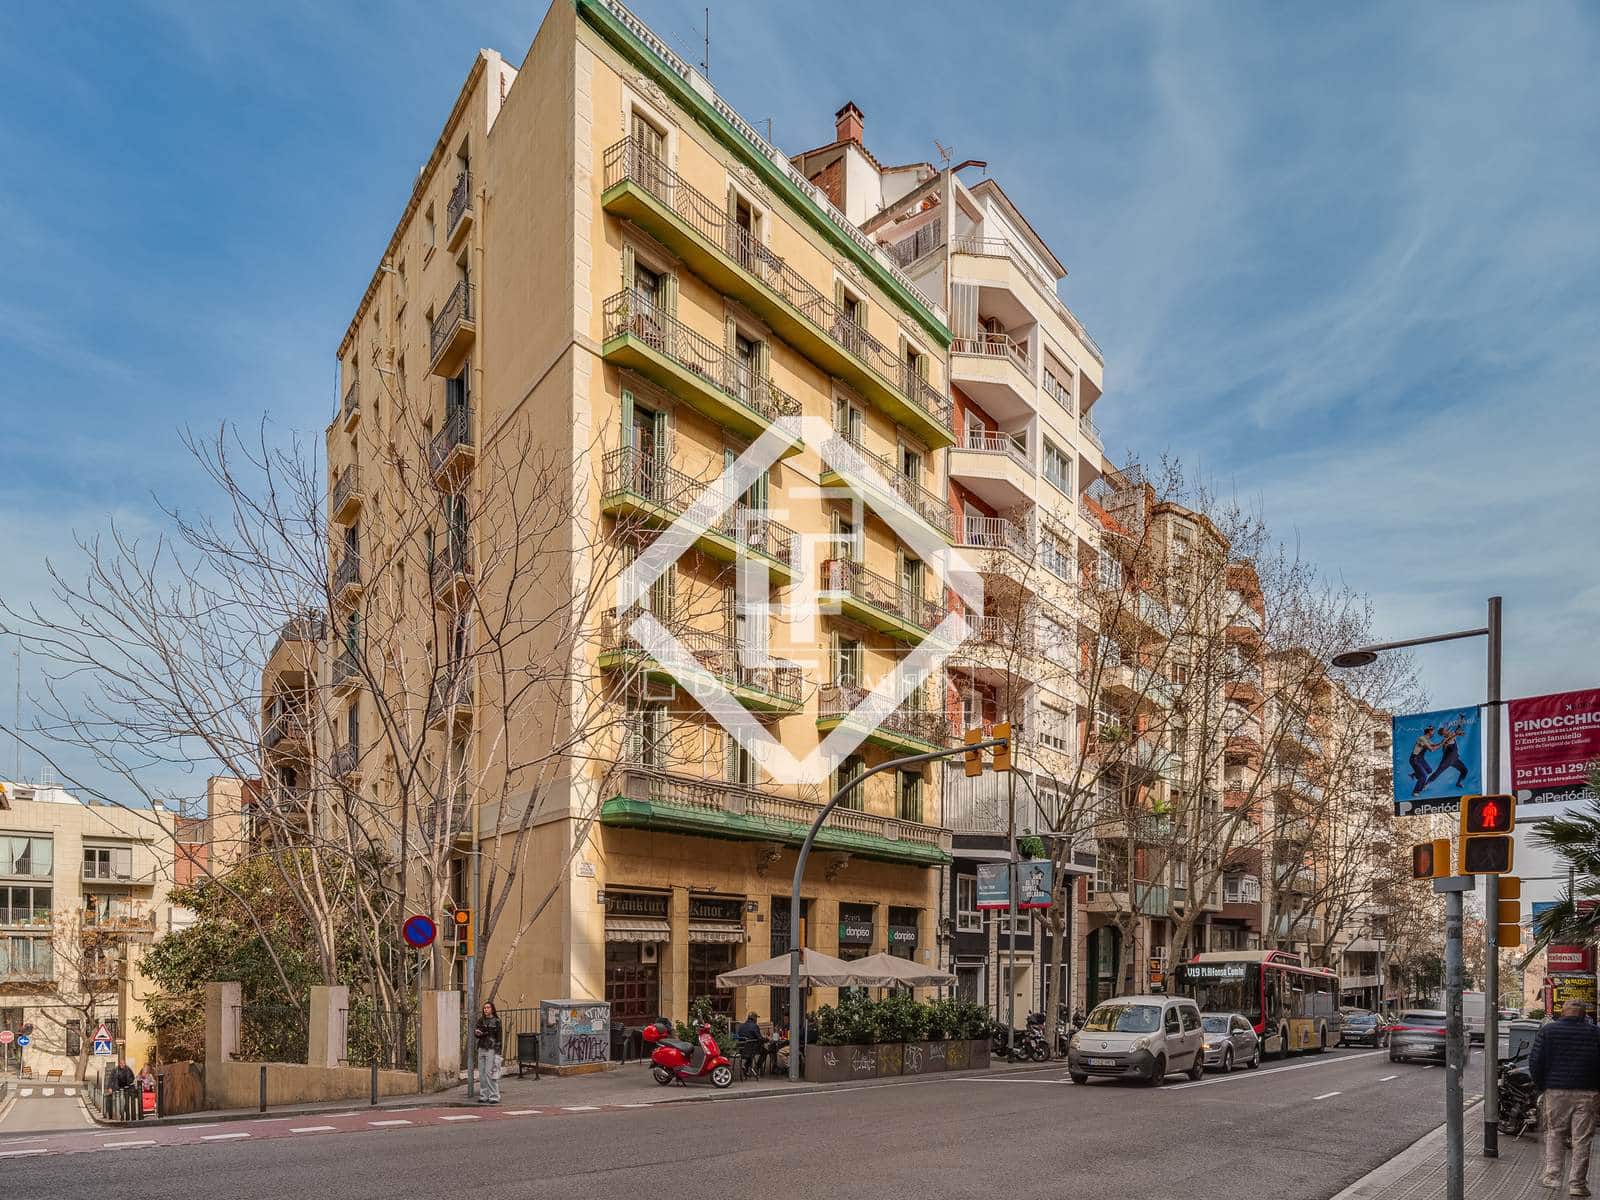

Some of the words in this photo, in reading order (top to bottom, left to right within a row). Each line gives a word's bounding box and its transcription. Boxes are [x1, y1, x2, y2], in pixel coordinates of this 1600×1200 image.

[1514, 712, 1600, 732] PINOCCHIO
[1517, 768, 1532, 778] De
[1534, 766, 1552, 776] l'11
[1555, 764, 1566, 774] al
[1415, 802, 1459, 815] elPeriód
[846, 926, 869, 938] donpiso
[894, 931, 915, 942] donpiso
